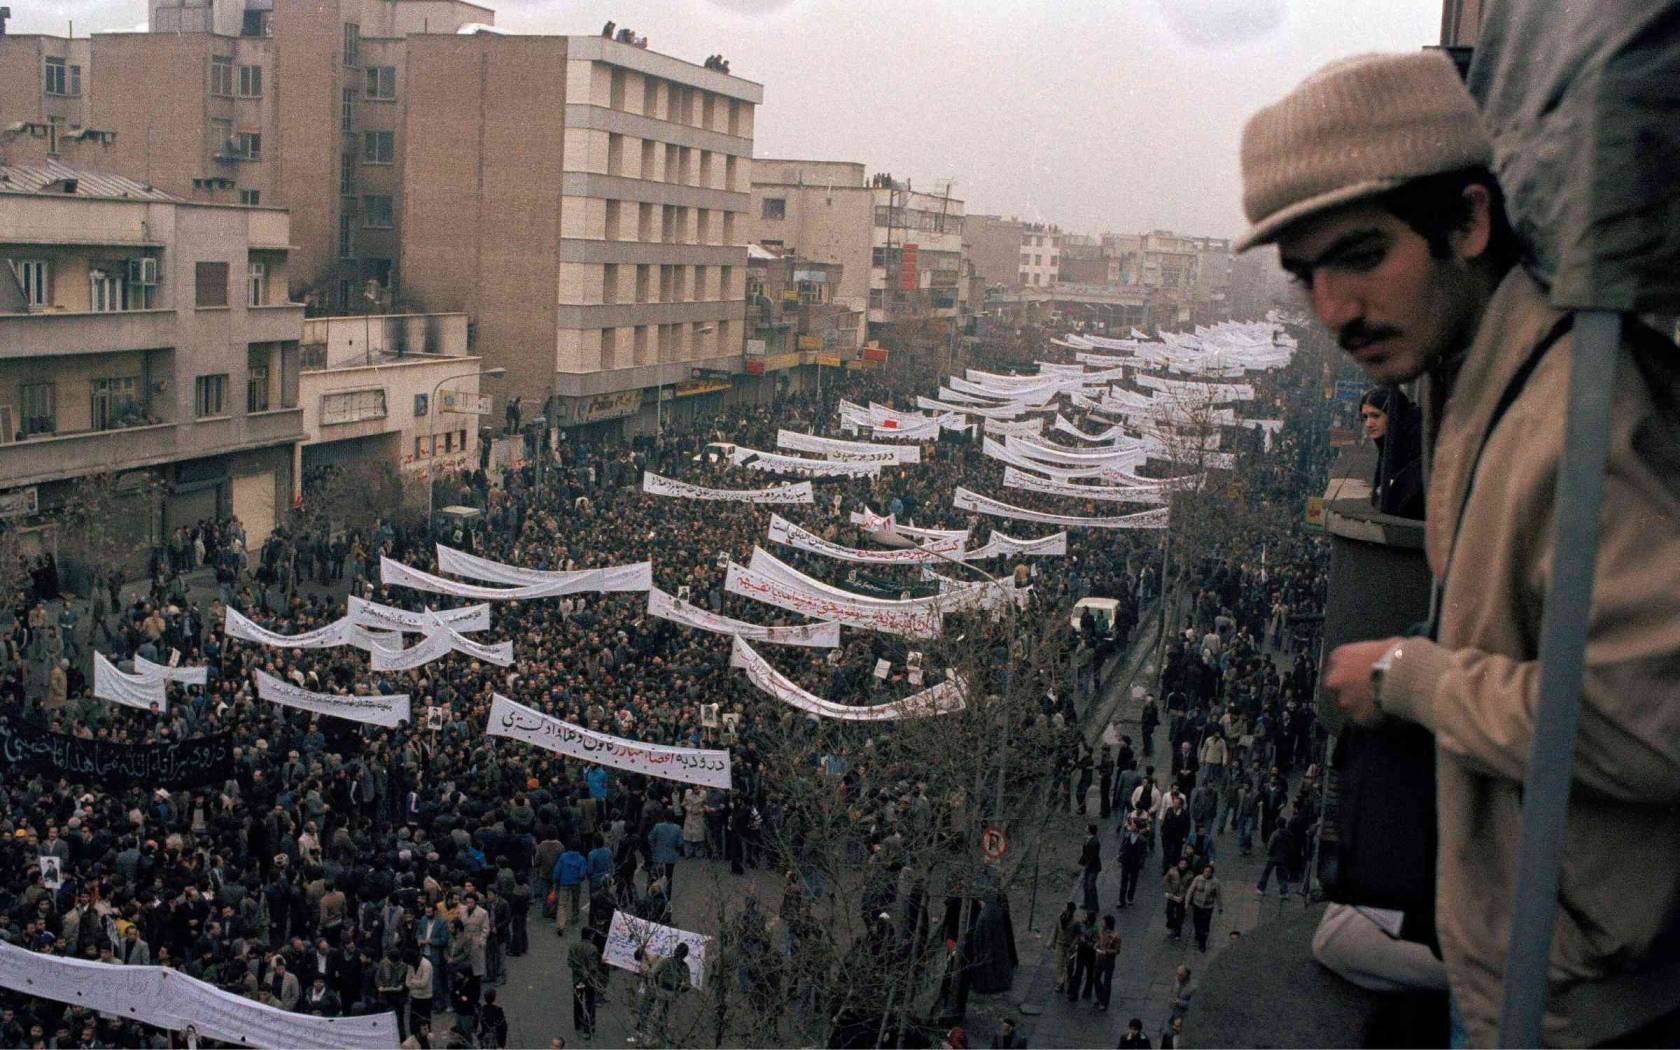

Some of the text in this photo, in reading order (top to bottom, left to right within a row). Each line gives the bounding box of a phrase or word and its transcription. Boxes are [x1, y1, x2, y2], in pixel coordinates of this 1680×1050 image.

[190, 745, 226, 768] درود
[676, 753, 689, 769] به
[689, 755, 725, 771] درود
[988, 833, 999, 850] P
